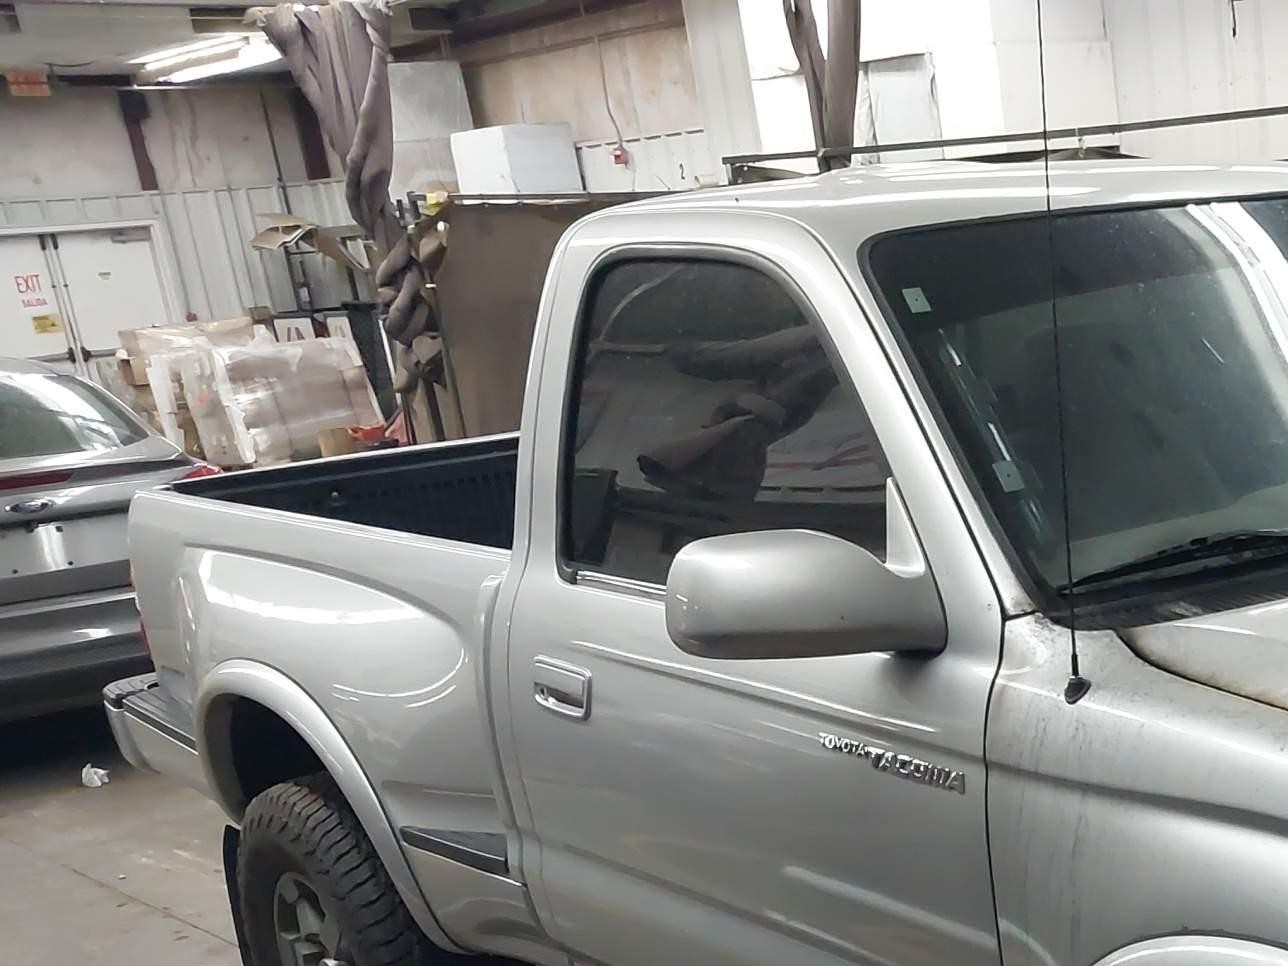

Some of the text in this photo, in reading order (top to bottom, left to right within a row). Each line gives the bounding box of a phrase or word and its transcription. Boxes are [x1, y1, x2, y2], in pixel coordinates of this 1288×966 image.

[14, 274, 41, 293] EXIT
[818, 732, 965, 794] TOYOTA TACOMA
